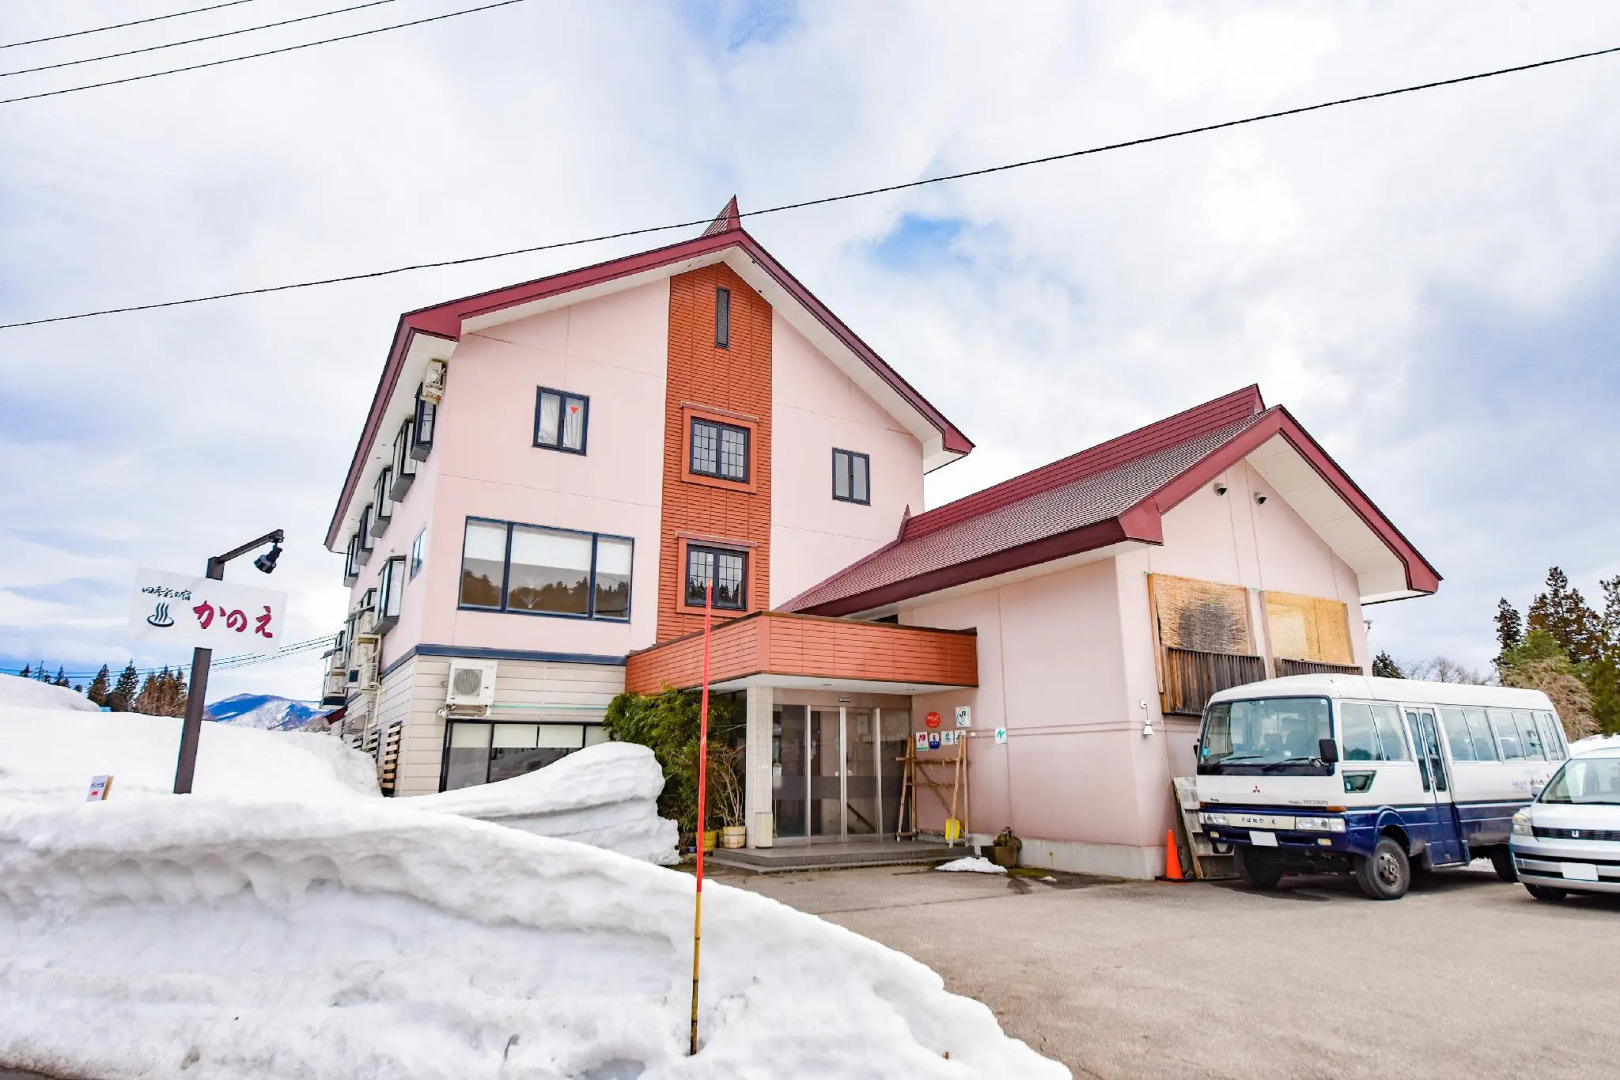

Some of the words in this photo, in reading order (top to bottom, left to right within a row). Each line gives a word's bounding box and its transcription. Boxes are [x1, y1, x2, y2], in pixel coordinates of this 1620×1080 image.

[141, 585, 192, 601] 四季彩の宿
[192, 600, 274, 638] かのえ
